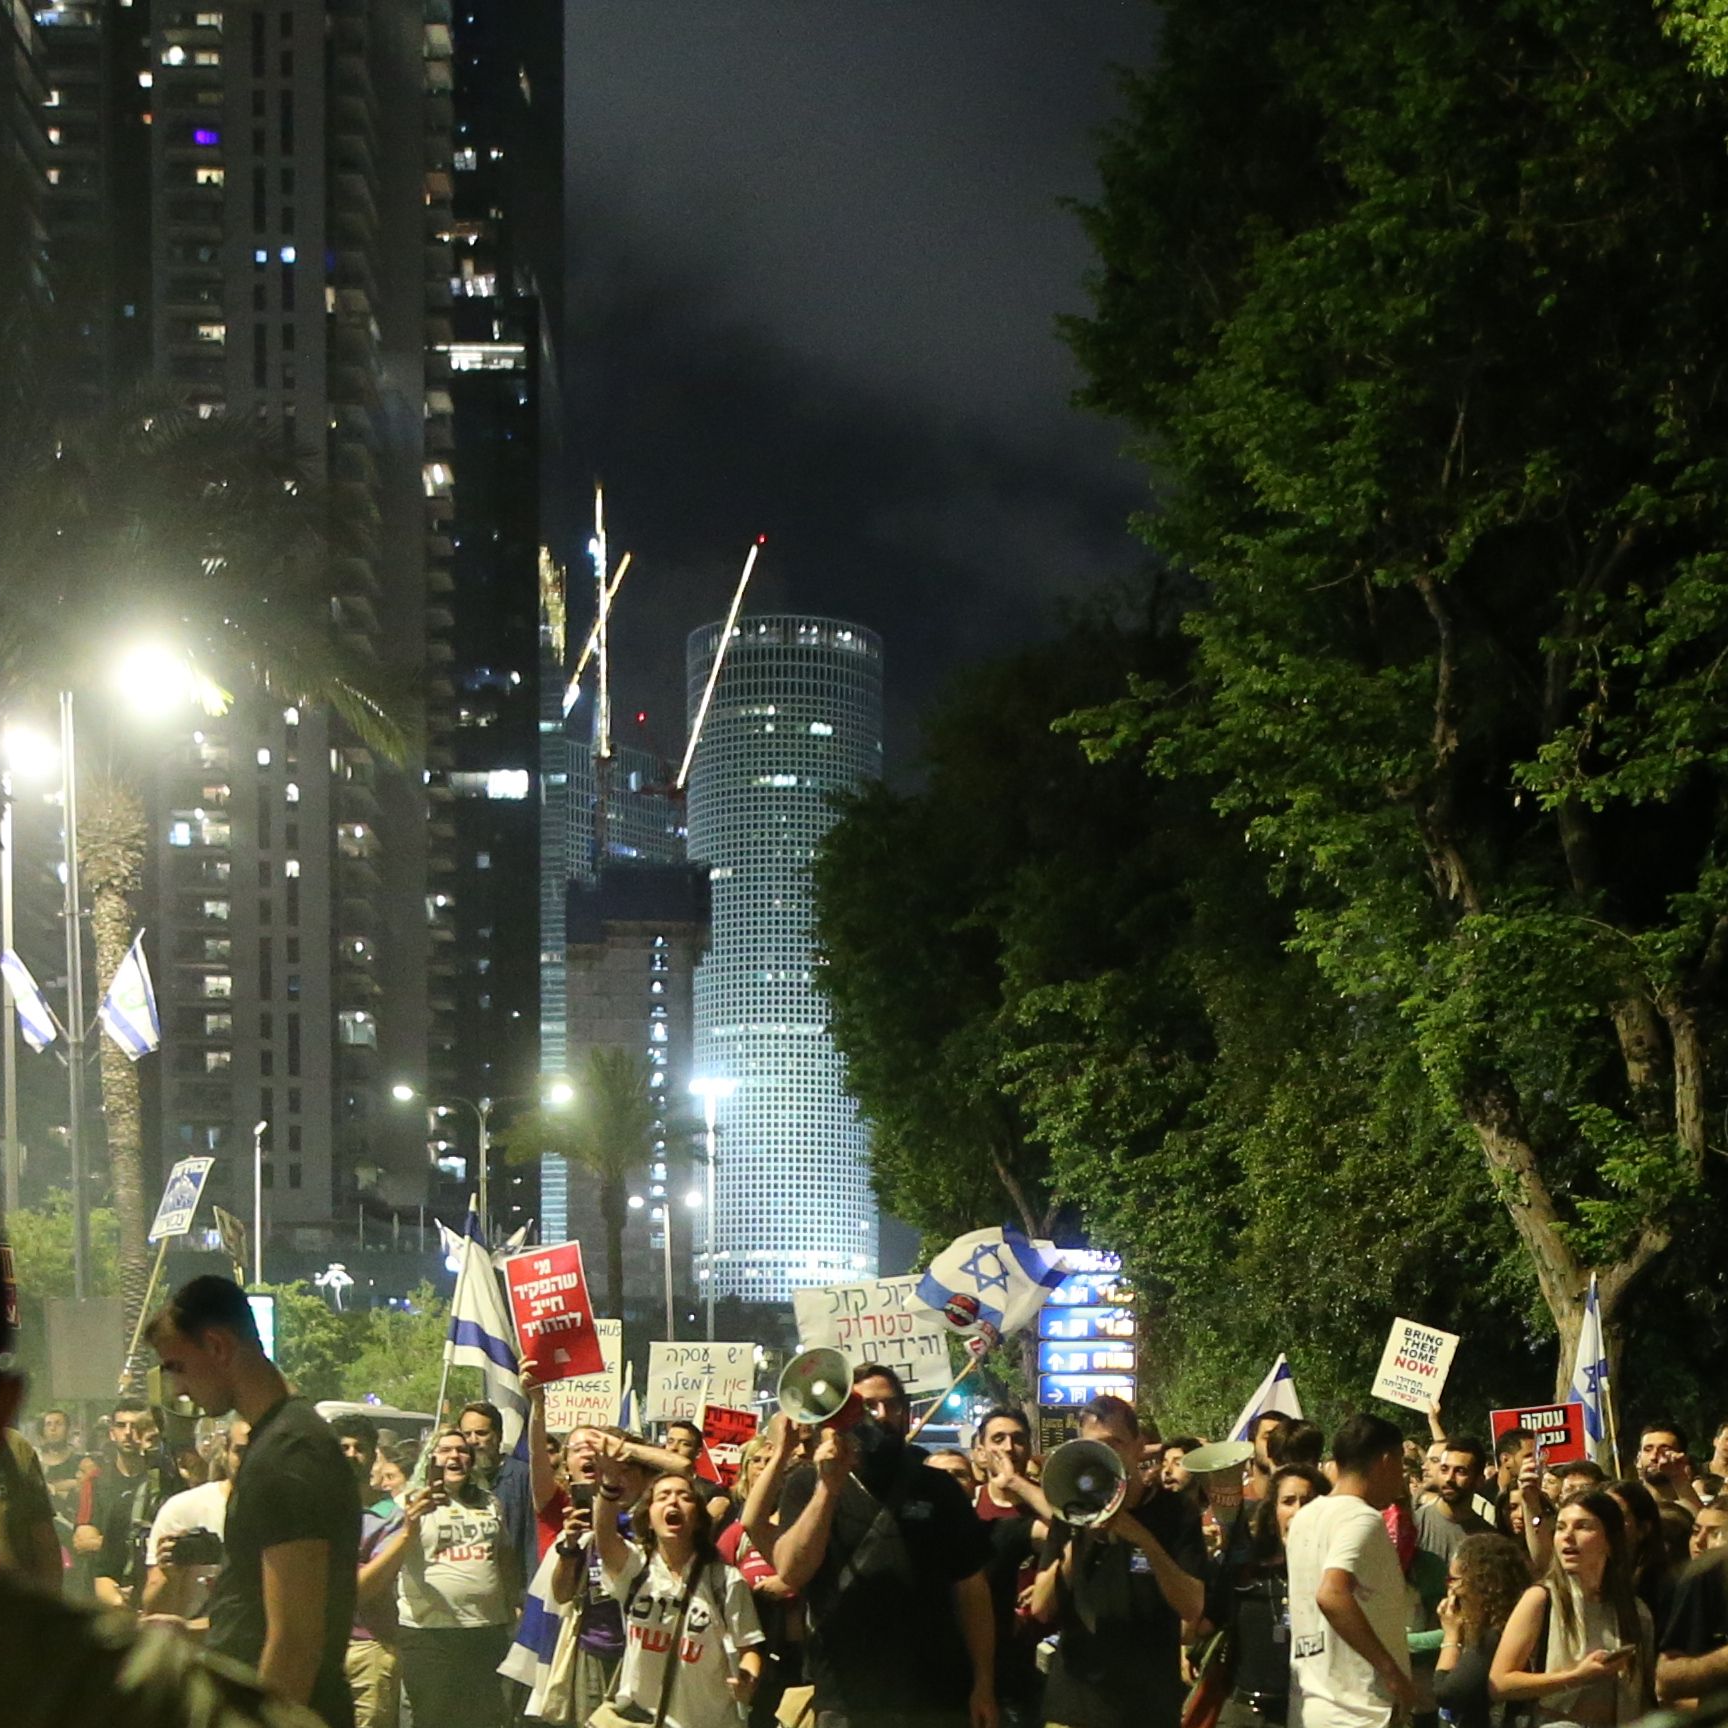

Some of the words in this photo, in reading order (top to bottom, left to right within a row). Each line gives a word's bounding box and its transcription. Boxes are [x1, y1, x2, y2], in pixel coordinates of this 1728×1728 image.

[533, 1258, 551, 1275] מי
[513, 1272, 578, 1300] שהפקיר
[530, 1295, 564, 1316] חייב
[824, 1288, 868, 1318] קול
[522, 1312, 582, 1338] להחזיר
[837, 1313, 913, 1350] סטרוק
[1404, 1327, 1444, 1346] BRING
[1404, 1337, 1440, 1355] THEM
[666, 1347, 710, 1366] עסקה
[728, 1347, 743, 1364] יש
[863, 1334, 941, 1364] והידים
[1400, 1346, 1437, 1364] HOME
[1394, 1356, 1439, 1379] NOW!
[544, 1379, 611, 1393] HOSTAGES
[544, 1395, 559, 1408] AS
[566, 1395, 613, 1410] HUMAN
[546, 1411, 609, 1427] SHIELD
[1520, 1410, 1564, 1430] עסקה
